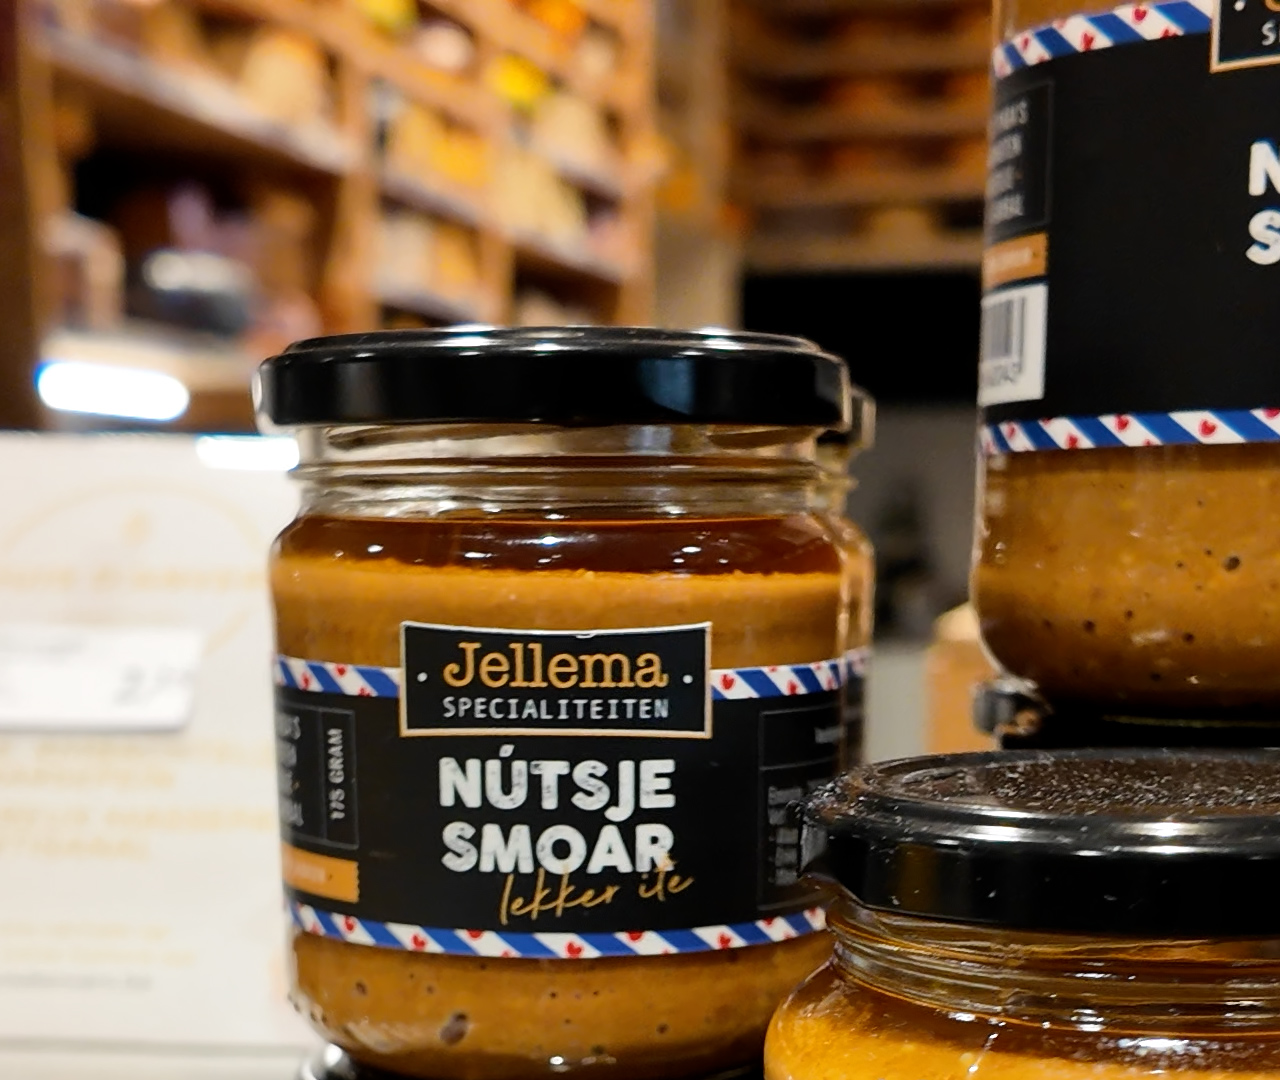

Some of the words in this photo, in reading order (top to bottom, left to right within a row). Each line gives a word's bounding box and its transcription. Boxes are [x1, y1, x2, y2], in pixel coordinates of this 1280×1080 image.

[442, 642, 669, 689] Jellema
[442, 696, 670, 721] SPECIALITEITEN
[326, 727, 345, 784] GRAM
[438, 744, 677, 821] NÚTSJE
[441, 821, 675, 875] SMOAR
[500, 865, 621, 925] lekker
